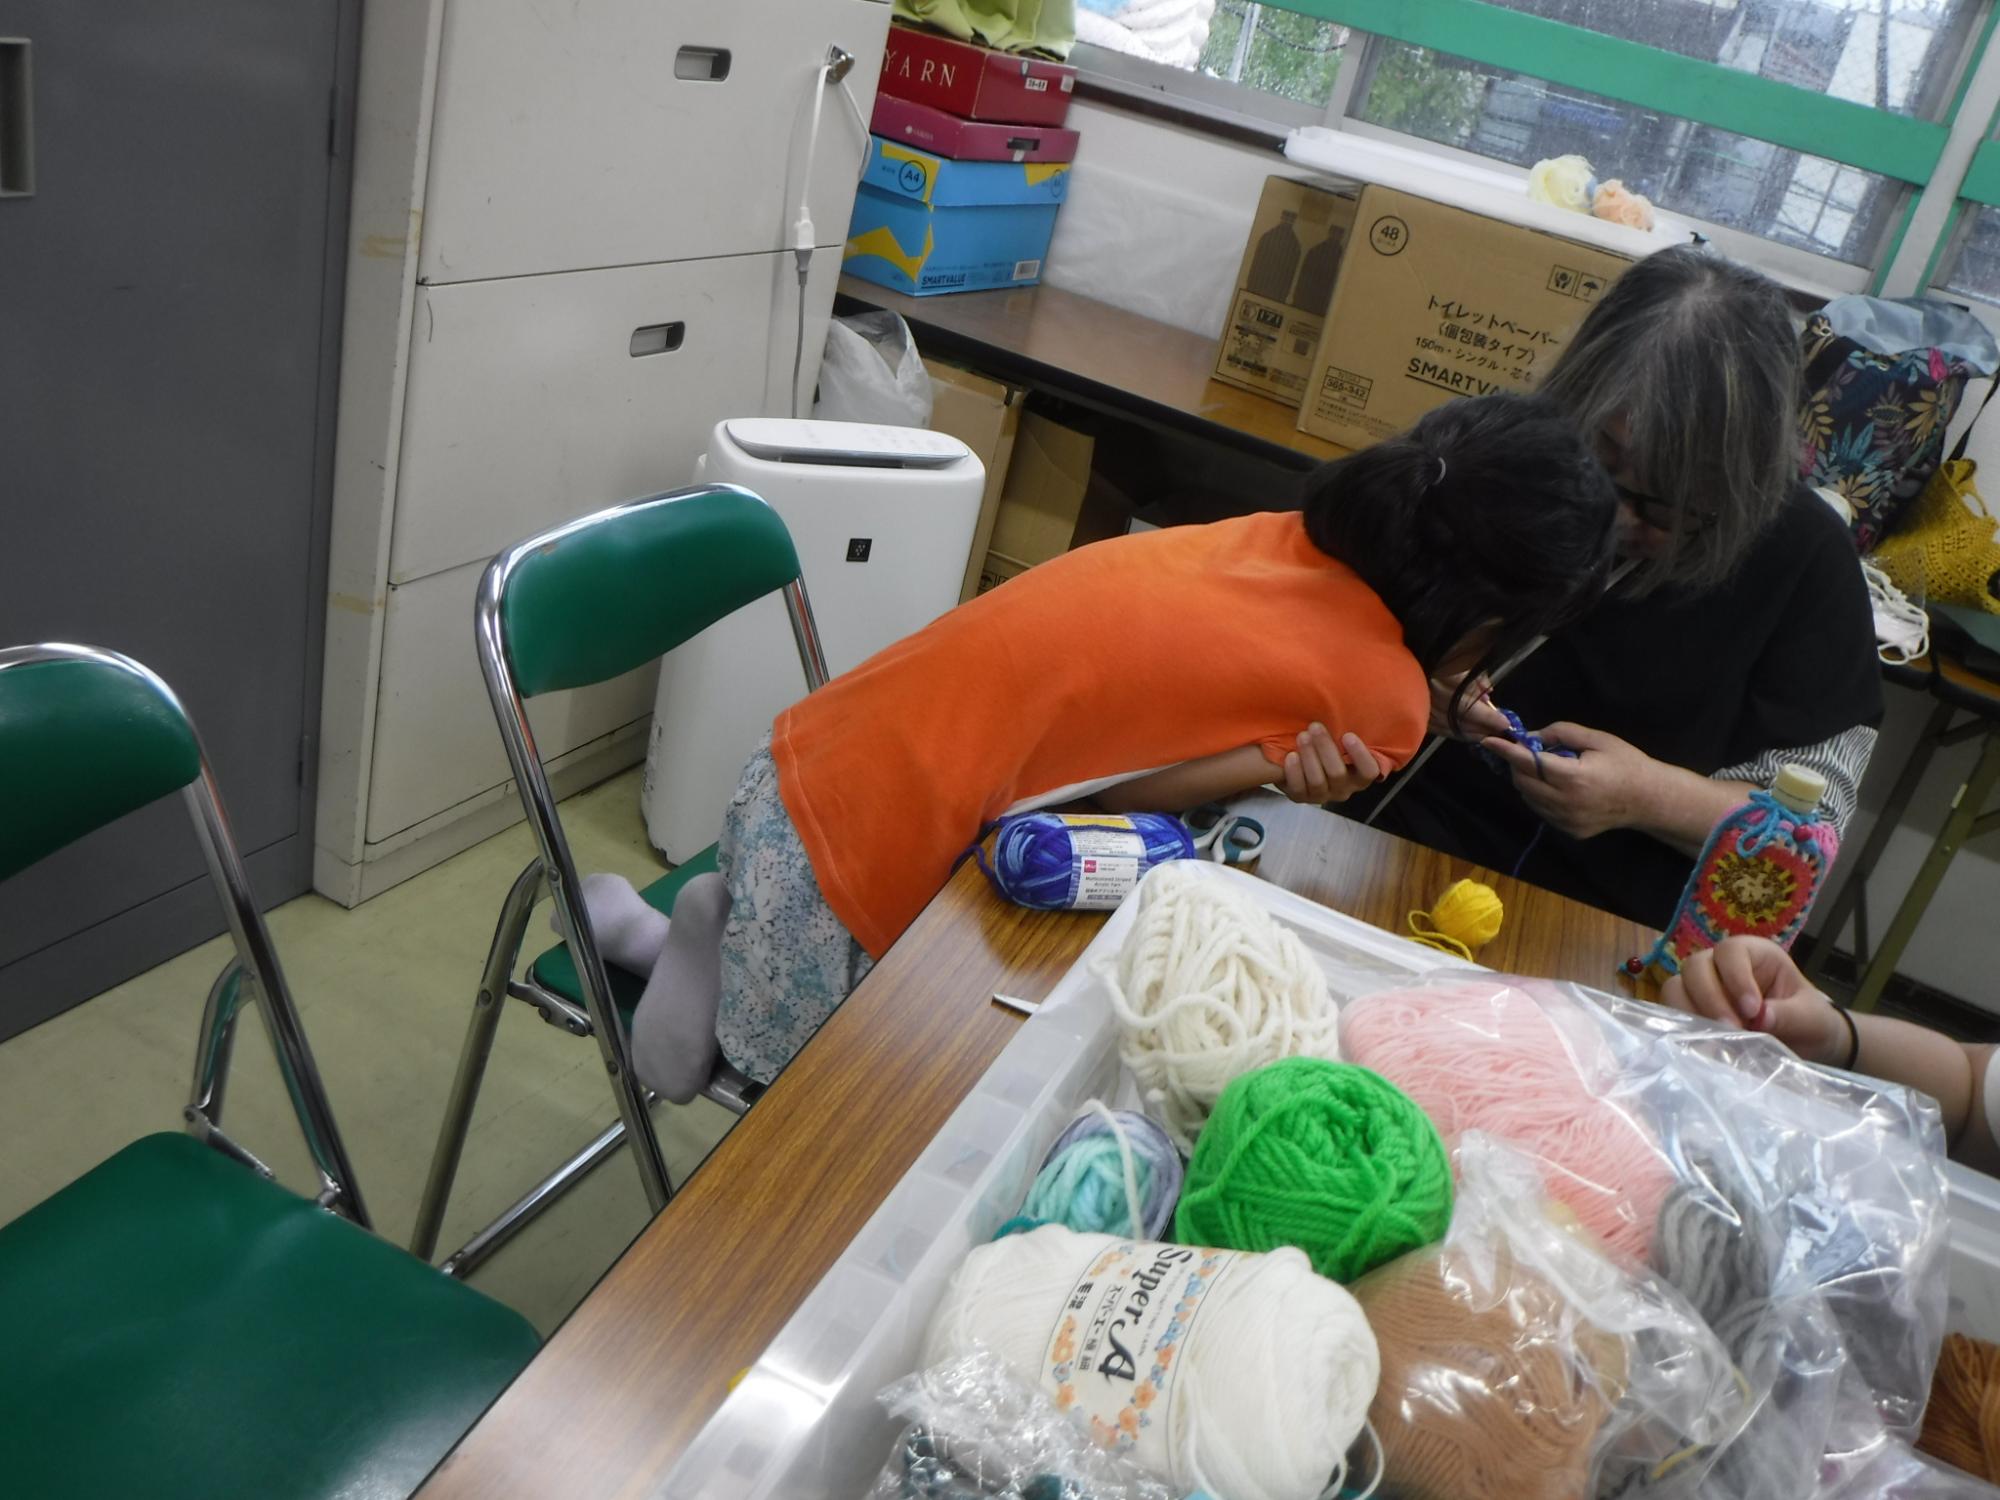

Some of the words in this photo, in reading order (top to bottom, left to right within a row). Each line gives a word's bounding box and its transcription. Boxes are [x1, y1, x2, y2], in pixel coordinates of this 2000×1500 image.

[884, 49, 956, 88] YARN
[904, 169, 920, 183] A4
[1381, 225, 1399, 241] 48
[1428, 295, 1559, 345] トイレットペーパー
[1407, 357, 1500, 396] SMARTVA
[1125, 1247, 1193, 1325] Super
[1097, 1318, 1137, 1386] A
